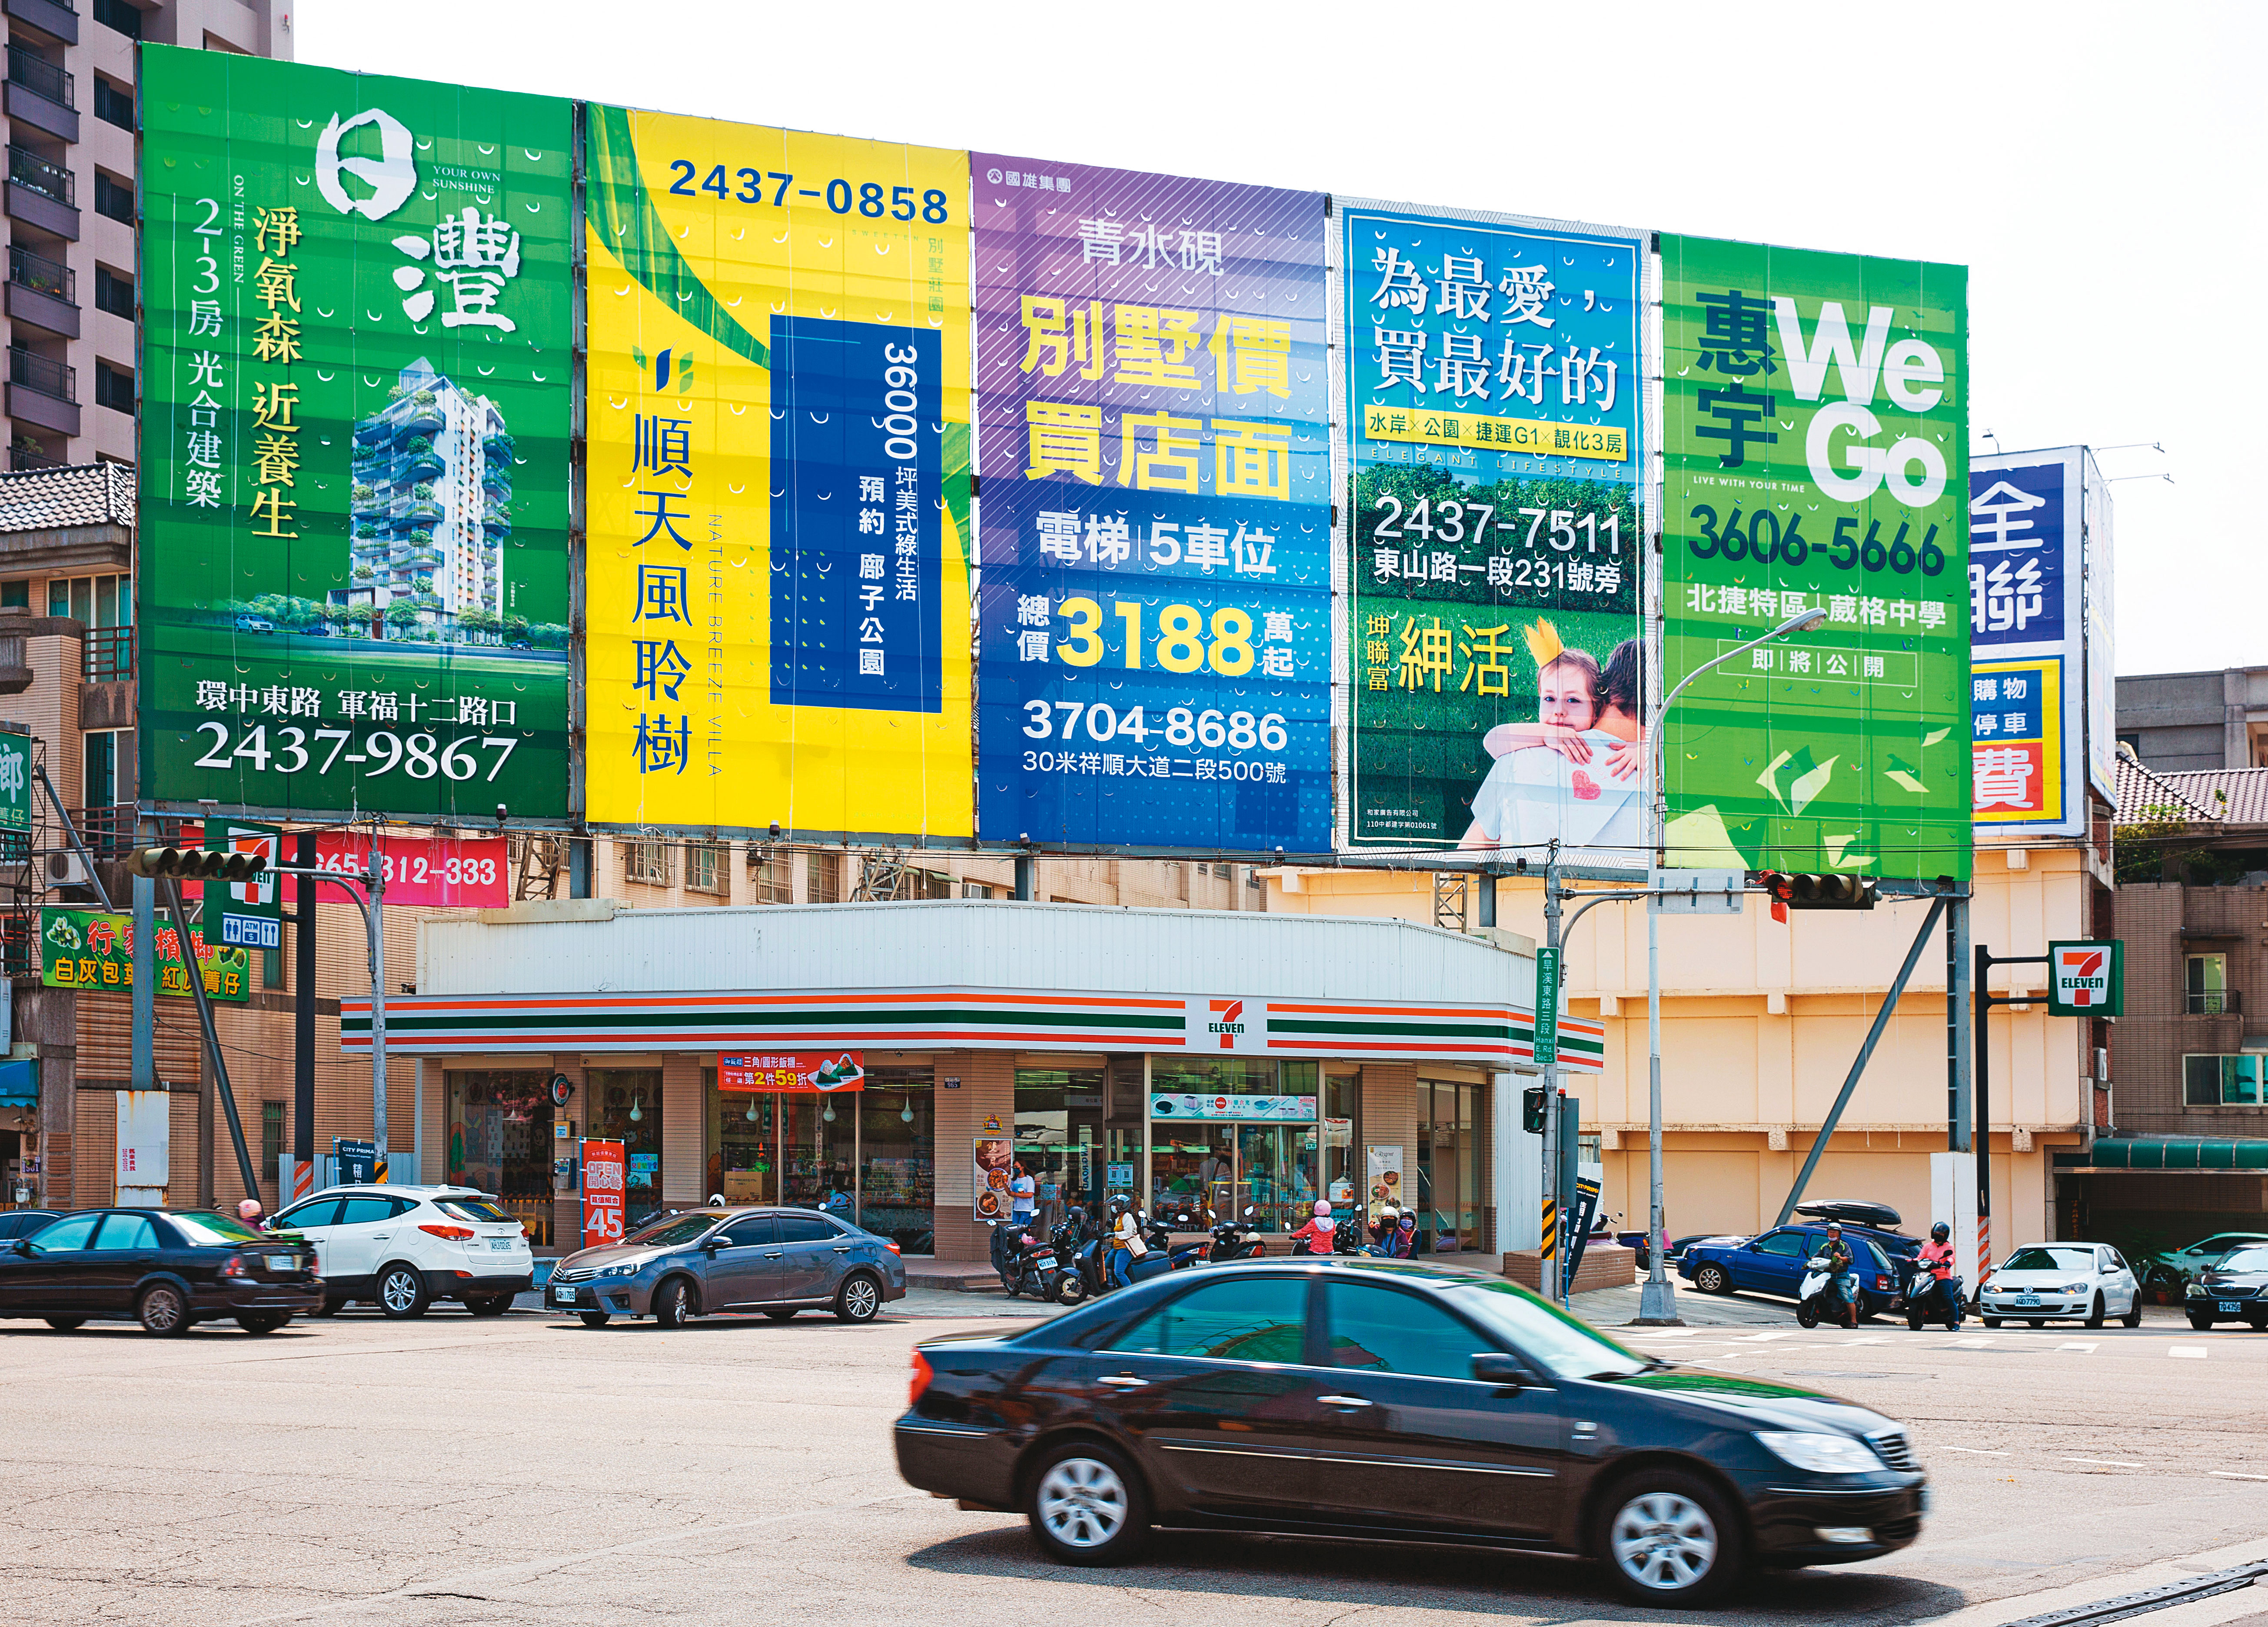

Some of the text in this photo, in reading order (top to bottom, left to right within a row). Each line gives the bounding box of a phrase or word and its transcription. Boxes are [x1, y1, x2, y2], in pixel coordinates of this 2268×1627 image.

[433, 166, 500, 181] YOUR OWN
[433, 179, 494, 194] SUNSHINE
[669, 159, 948, 224] 2437-0858
[1006, 171, 1071, 193] 國雄集團
[234, 175, 243, 283] ON THE GREEN
[852, 230, 918, 241] SWEETEN
[1078, 218, 1224, 275] 青水硯
[928, 238, 943, 312] 別墅莊園
[249, 206, 303, 539] 淨氧森 近養生
[1019, 294, 1292, 399] 別墅價
[1373, 326, 1617, 412] 買最好的
[1770, 296, 1944, 413] We
[1695, 289, 1778, 468] 惠宇
[186, 350, 223, 508] 光合建築
[1024, 400, 1292, 501] 買店面
[1806, 401, 1947, 507] Go
[884, 343, 918, 601] 36000 坪美式綠生活
[1372, 448, 1622, 479] ELEGANT LIFESTYLE
[1693, 476, 1805, 493] LIVE WITH YOUR TIME
[859, 476, 885, 534] 預約
[1374, 496, 1619, 555] 2437-7511
[1036, 511, 1276, 574] 電梯 5車位
[1688, 504, 1945, 576] 3606-5666
[631, 413, 694, 775] 順天風聆樹
[1373, 547, 1621, 594] 東山路一段231號旁
[1017, 594, 1294, 677] 總價 3188 萬起
[1686, 582, 1946, 629] 北捷特區 葳格中學
[708, 514, 723, 777] NATURE BREEZE VILLA
[1366, 615, 1513, 697] 坤聯富 紳活
[196, 679, 516, 726] 環中東路 軍福十二路口
[1973, 676, 2027, 701] 購物
[194, 721, 518, 782] 2437-9867
[1023, 700, 1287, 751] 3704-8686
[1973, 712, 2027, 736] 停車
[1022, 751, 1287, 784] 30米祥順大道二段500號
[1972, 747, 2034, 809] 費
[1541, 959, 1553, 1035] 旱溪東路三段
[2063, 952, 2102, 1006] 7
[1210, 1000, 1242, 1048] 7
[744, 1070, 807, 1086] 第2件59折
[589, 1163, 620, 1175] OPEN
[587, 1208, 623, 1238] 45
